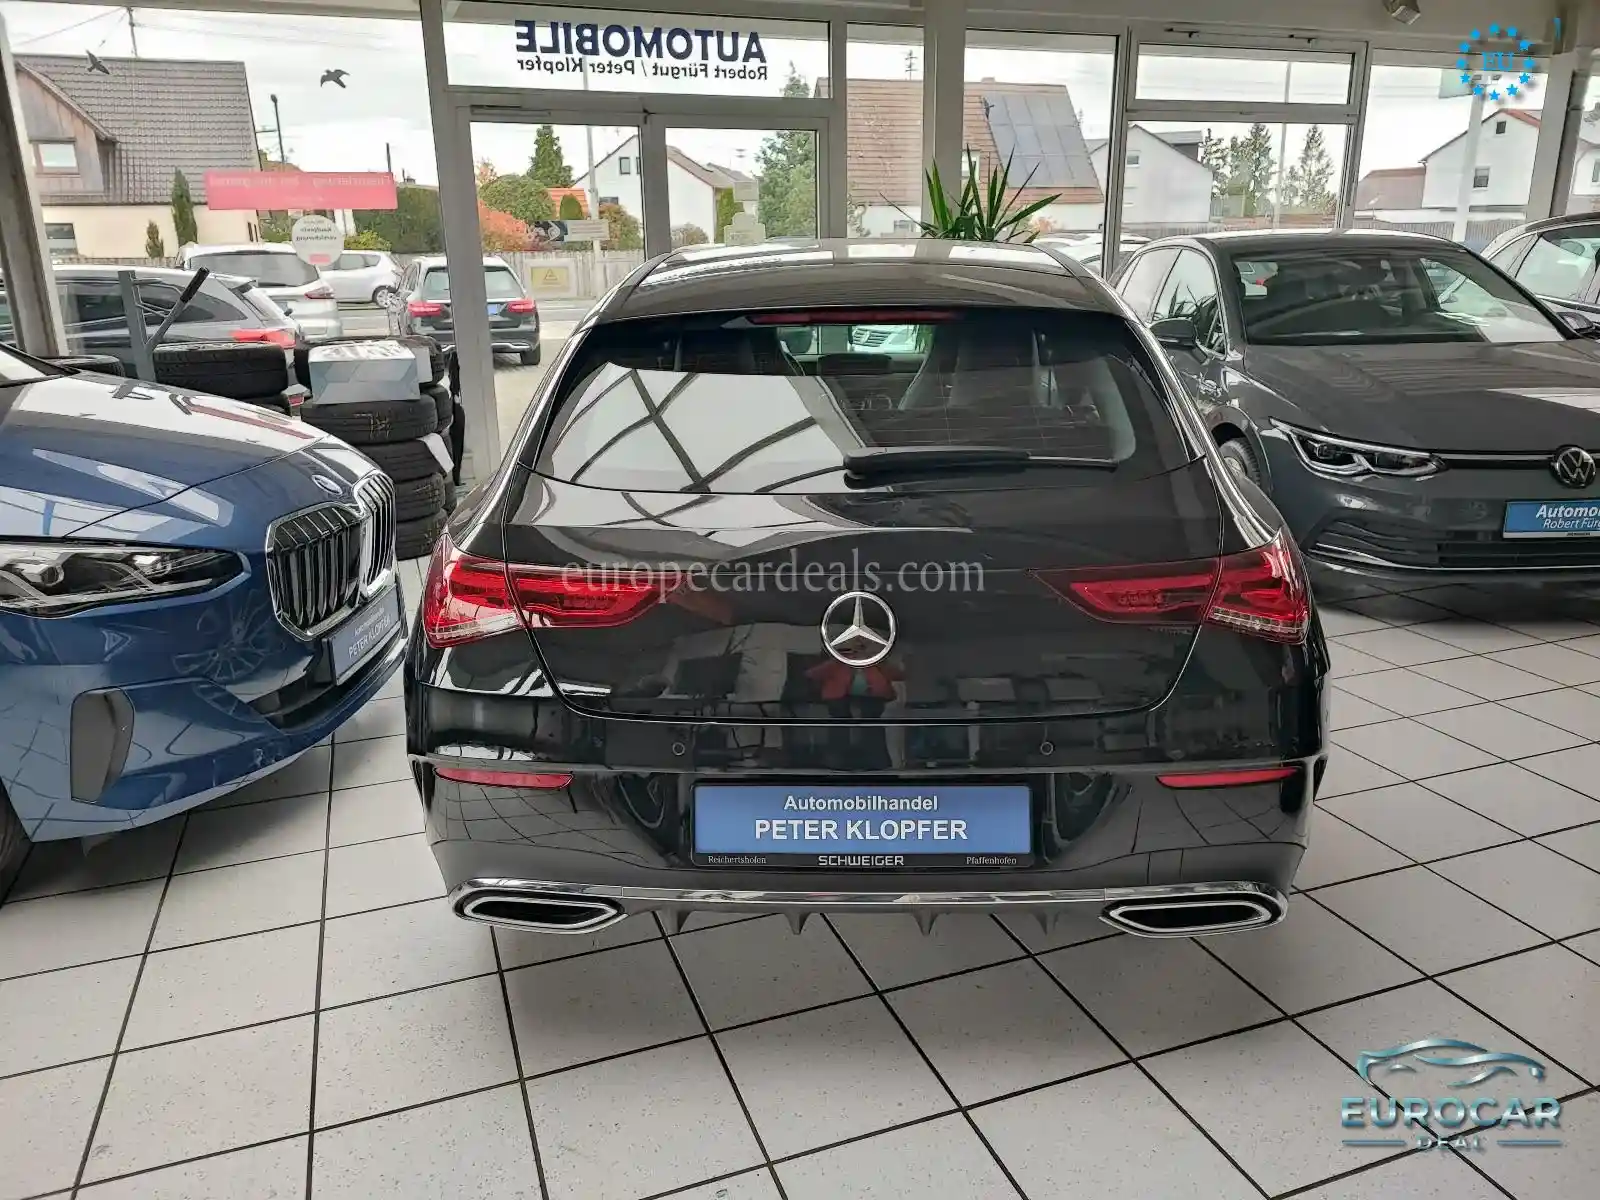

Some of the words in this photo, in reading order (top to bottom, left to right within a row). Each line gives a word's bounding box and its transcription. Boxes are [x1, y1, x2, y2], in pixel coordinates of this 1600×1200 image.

[1536, 504, 1600, 518] Automo
[1543, 519, 1579, 529] Robert
[783, 795, 938, 811] Automobilhandel
[754, 819, 838, 840] PETER
[846, 819, 968, 840] KLOPFER
[707, 855, 767, 864] Reichertshofen
[818, 855, 905, 866] SCHWEIGER
[966, 855, 1017, 866] Pfaffenhofen
